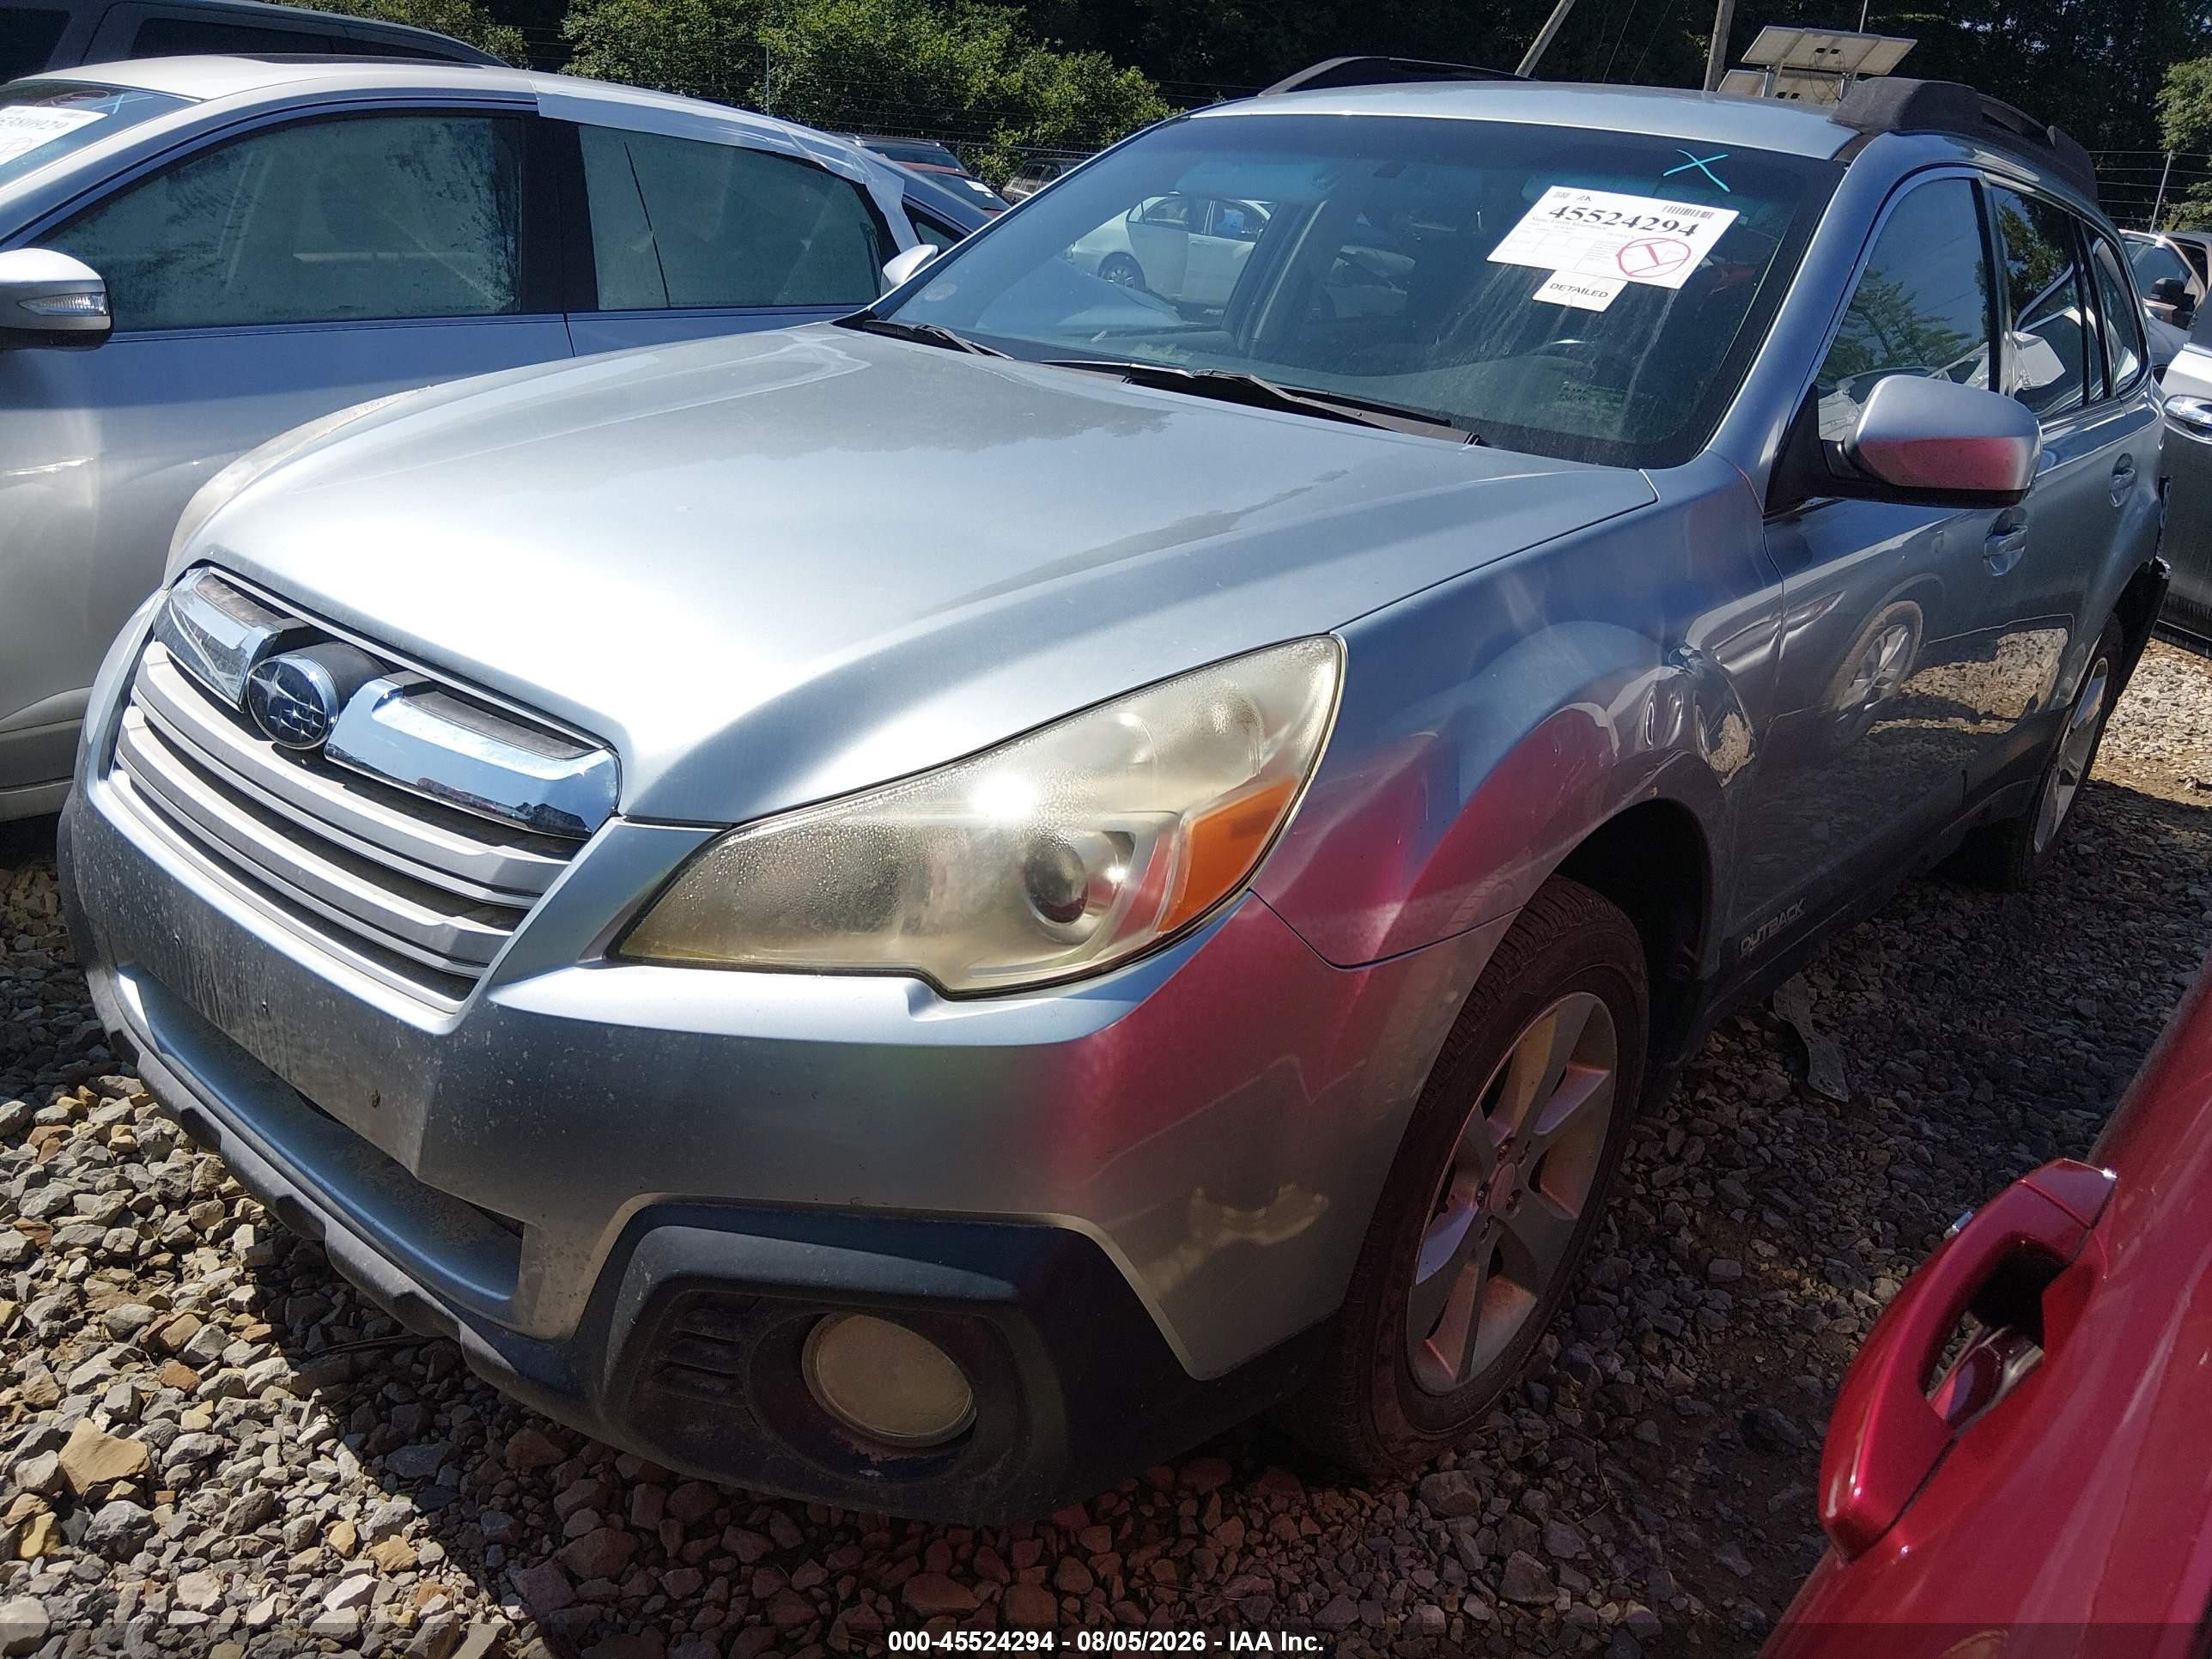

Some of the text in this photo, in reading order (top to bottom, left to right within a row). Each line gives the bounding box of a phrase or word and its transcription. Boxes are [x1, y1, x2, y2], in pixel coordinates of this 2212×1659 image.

[1548, 205, 1699, 237] 45524294
[1548, 283, 1609, 299] DETAILED
[1741, 898, 1806, 953] OUTBACK
